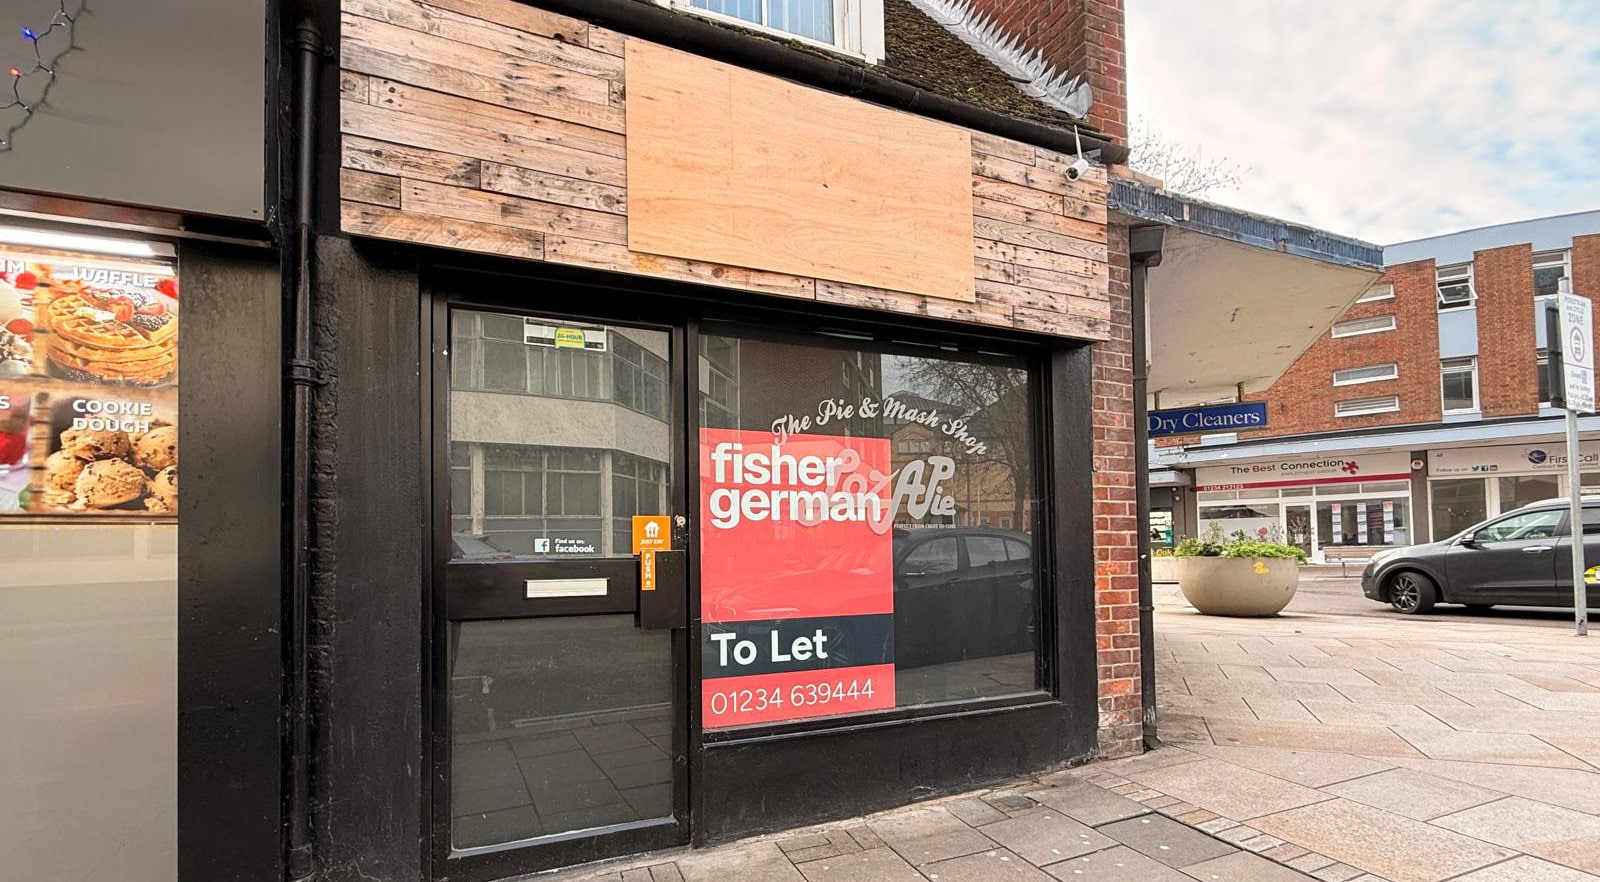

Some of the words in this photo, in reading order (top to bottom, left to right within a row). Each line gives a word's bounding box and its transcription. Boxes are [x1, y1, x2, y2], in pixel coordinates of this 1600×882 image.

[73, 267, 156, 288] WAFFLE
[72, 399, 153, 417] COOKIE
[72, 417, 150, 434] DOUGH
[772, 414, 811, 446] The
[815, 398, 854, 425] Pie
[859, 397, 879, 418] &
[884, 397, 938, 428] Mash
[941, 418, 987, 456] Shop
[1148, 415, 1178, 434] Dry
[1182, 412, 1260, 428] Cleaners
[711, 443, 842, 486] fisher
[1280, 460, 1344, 470] Connection
[1549, 453, 1568, 464] Firs
[709, 487, 881, 529] german
[555, 544, 595, 553] facebook
[710, 633, 757, 666] To
[771, 629, 828, 663] Let
[711, 688, 784, 715] 01234
[790, 678, 875, 707] 639444
